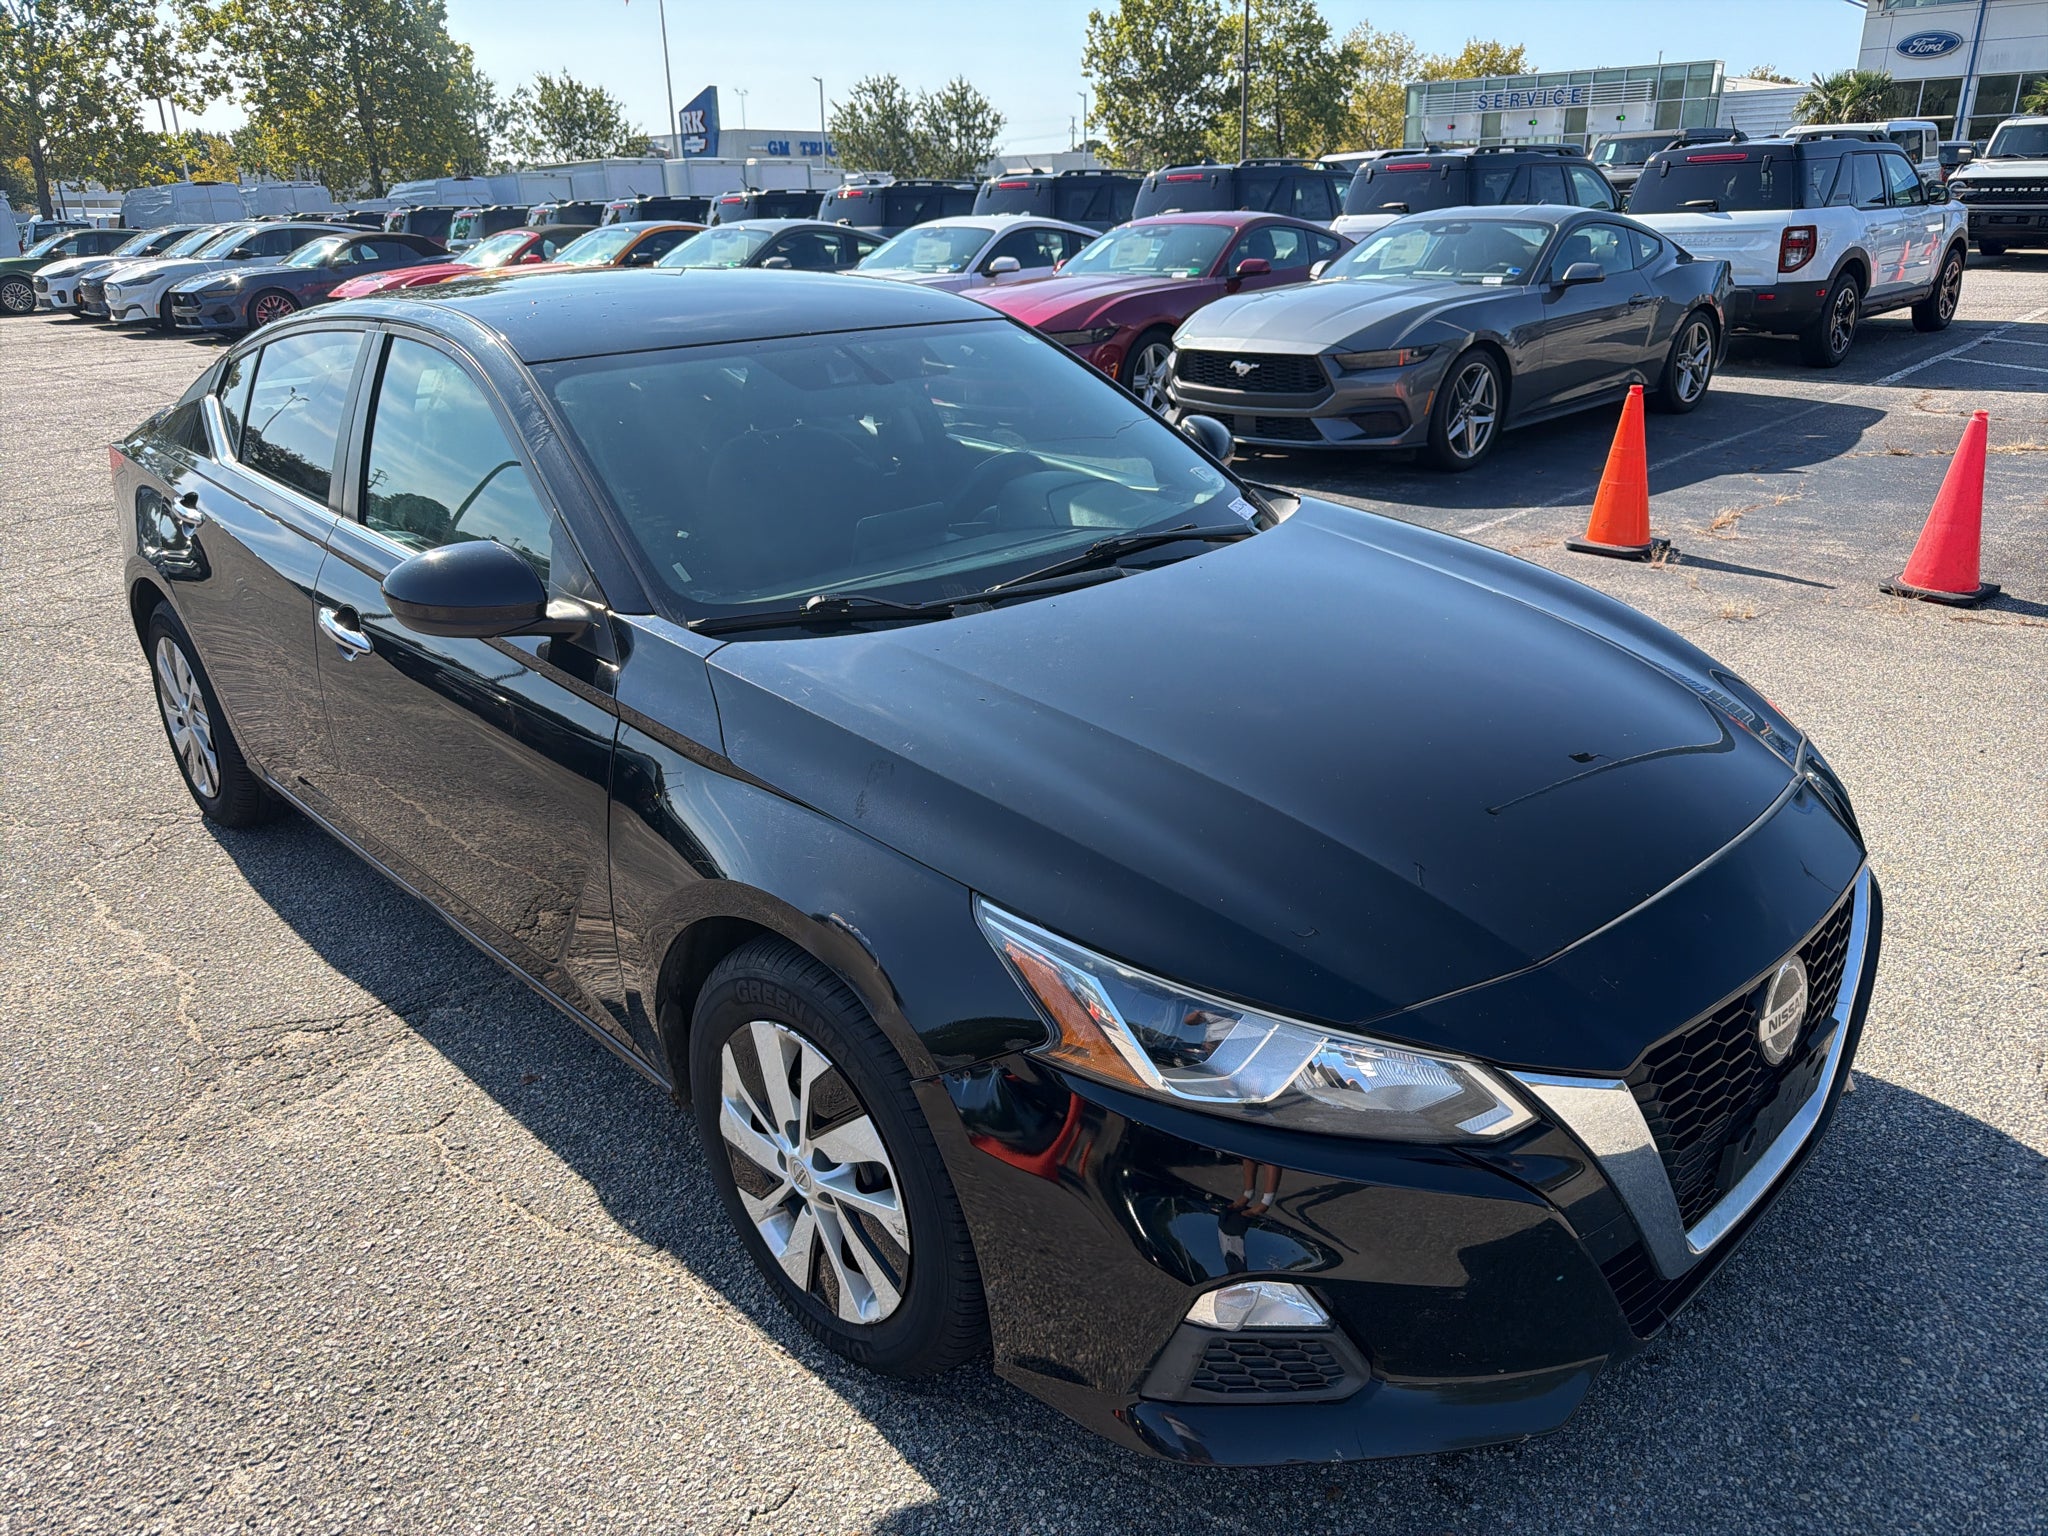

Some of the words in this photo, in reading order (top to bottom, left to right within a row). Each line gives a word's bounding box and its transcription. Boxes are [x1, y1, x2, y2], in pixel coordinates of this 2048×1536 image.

[1908, 37, 1946, 53] Ford
[1478, 88, 1582, 109] SERVICE
[680, 110, 706, 134] RK
[767, 140, 791, 156] GM
[800, 141, 836, 157] TRUC
[1767, 996, 1802, 1034] NISSA
